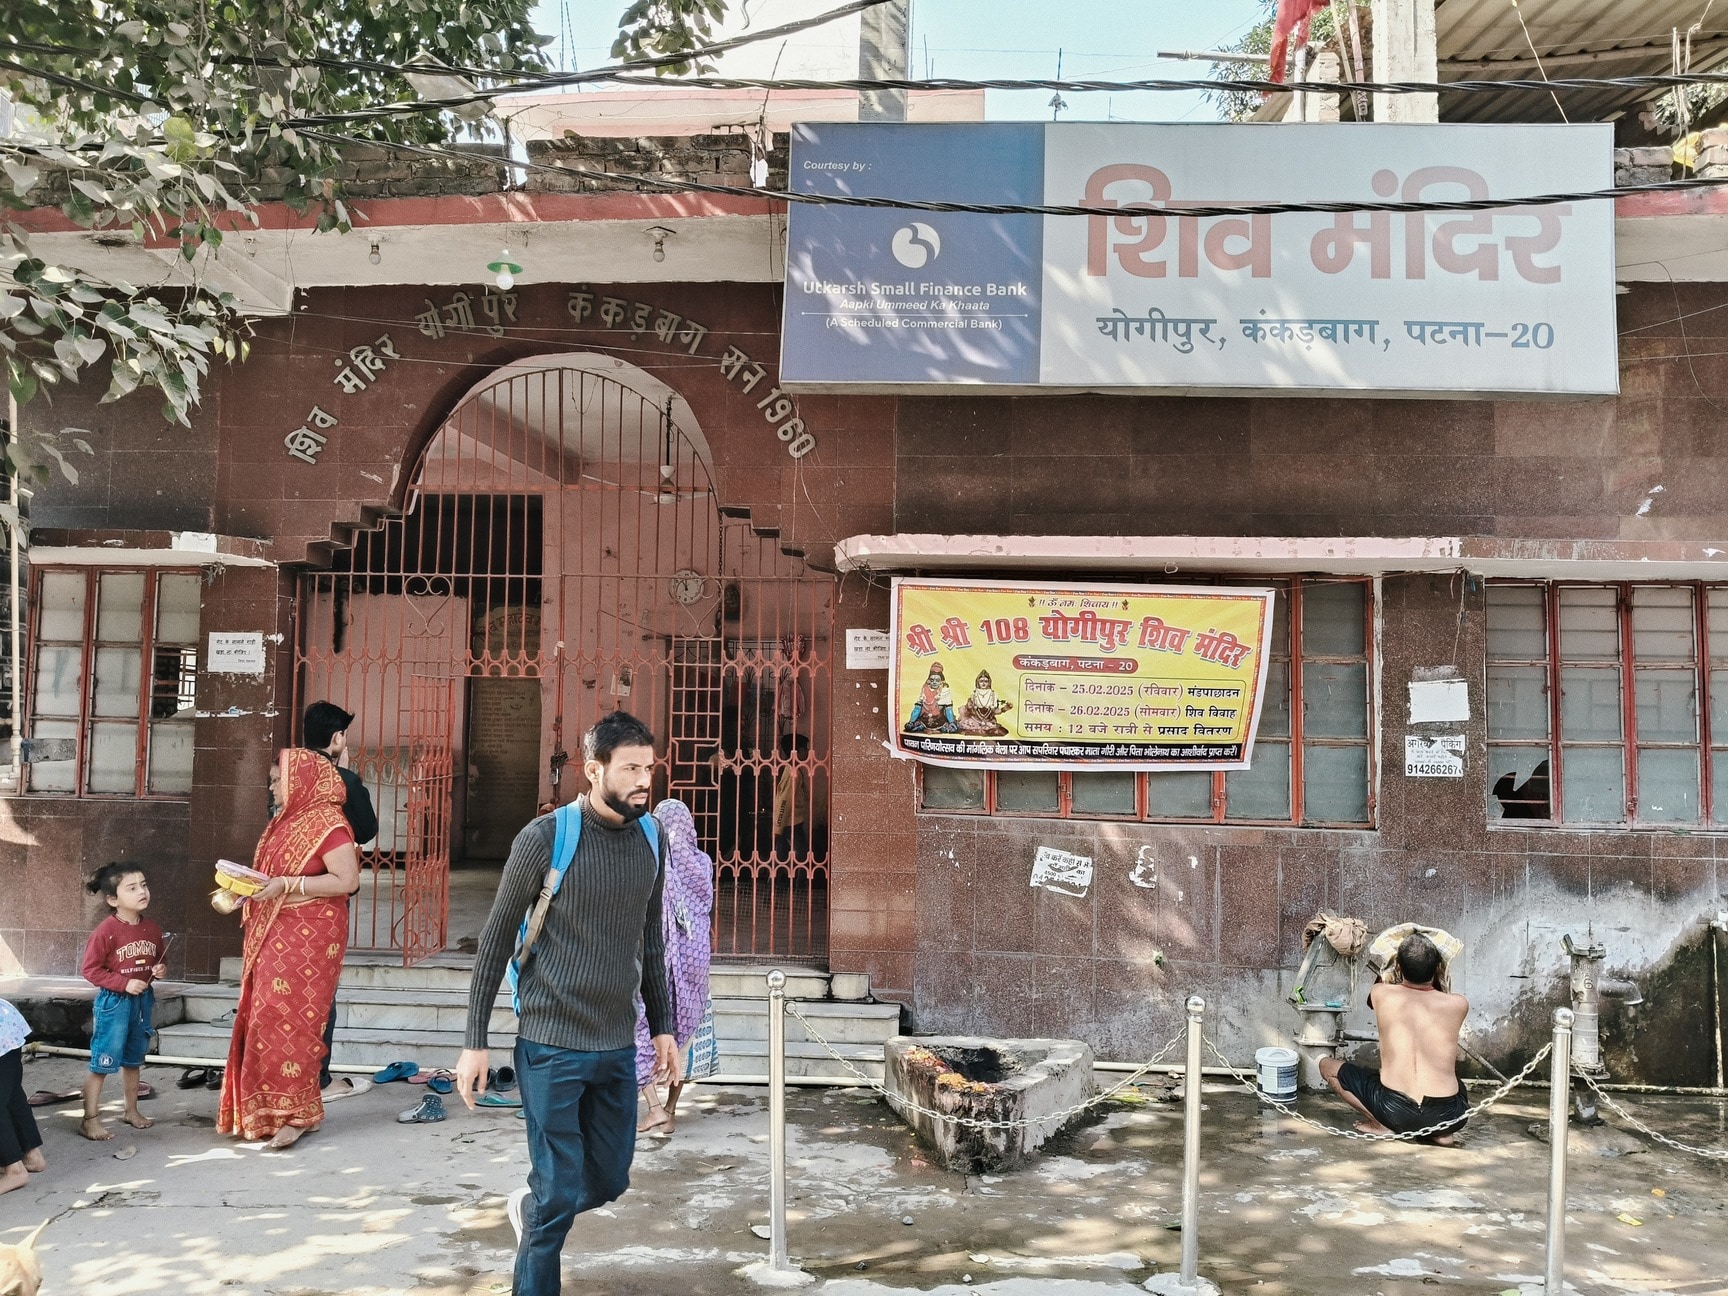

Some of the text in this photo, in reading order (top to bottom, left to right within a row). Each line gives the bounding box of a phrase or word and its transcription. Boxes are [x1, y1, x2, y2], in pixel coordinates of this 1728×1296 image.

[803, 160, 850, 171] Courtesy
[852, 160, 866, 173] by
[1078, 163, 1572, 284] शिव मंदिर
[803, 281, 1027, 296] Utkarsh Small Finance Bank
[839, 300, 990, 311] Aapki Ummeed Ka Khaata
[825, 318, 1003, 330] (A Scheduled Commercial Bank)
[1096, 307, 1227, 355] योगीपुर,
[1239, 309, 1391, 353] कंकड़बाग,
[284, 404, 340, 465] शिव
[333, 333, 401, 394] मंदिर
[756, 386, 817, 459] 1960
[1080, 598, 1110, 609] शिवाय
[905, 609, 1253, 670] श्री श्री 108 योगीपुर शिव मंदिर
[1018, 656, 1074, 670] कंकड़बाग,
[1077, 659, 1104, 670] पटना
[1118, 661, 1133, 671] 20
[1024, 679, 1056, 692] दिनांक
[1072, 684, 1134, 696] 25.02.2025
[1138, 682, 1184, 700] (रविवार)
[1024, 699, 1054, 713] दिनांक
[1070, 705, 1130, 717] 26.02.2025
[1134, 703, 1181, 720] (सोमवार)
[1185, 705, 1205, 718] शिव
[1208, 705, 1237, 719] विवाह
[1024, 722, 1053, 733] समय
[1068, 724, 1083, 734] 12
[1112, 722, 1139, 735] रात्री
[1143, 723, 1153, 735] से
[1157, 726, 1189, 736] प्रसाद
[1193, 723, 1233, 736] वितरण
[956, 741, 966, 753] की
[1009, 744, 1018, 755] पर
[1018, 744, 1031, 755] आप
[1032, 743, 1059, 756] सपरिवार
[1115, 744, 1129, 756] और
[1129, 744, 1143, 757] पिता
[1170, 747, 1180, 757] का
